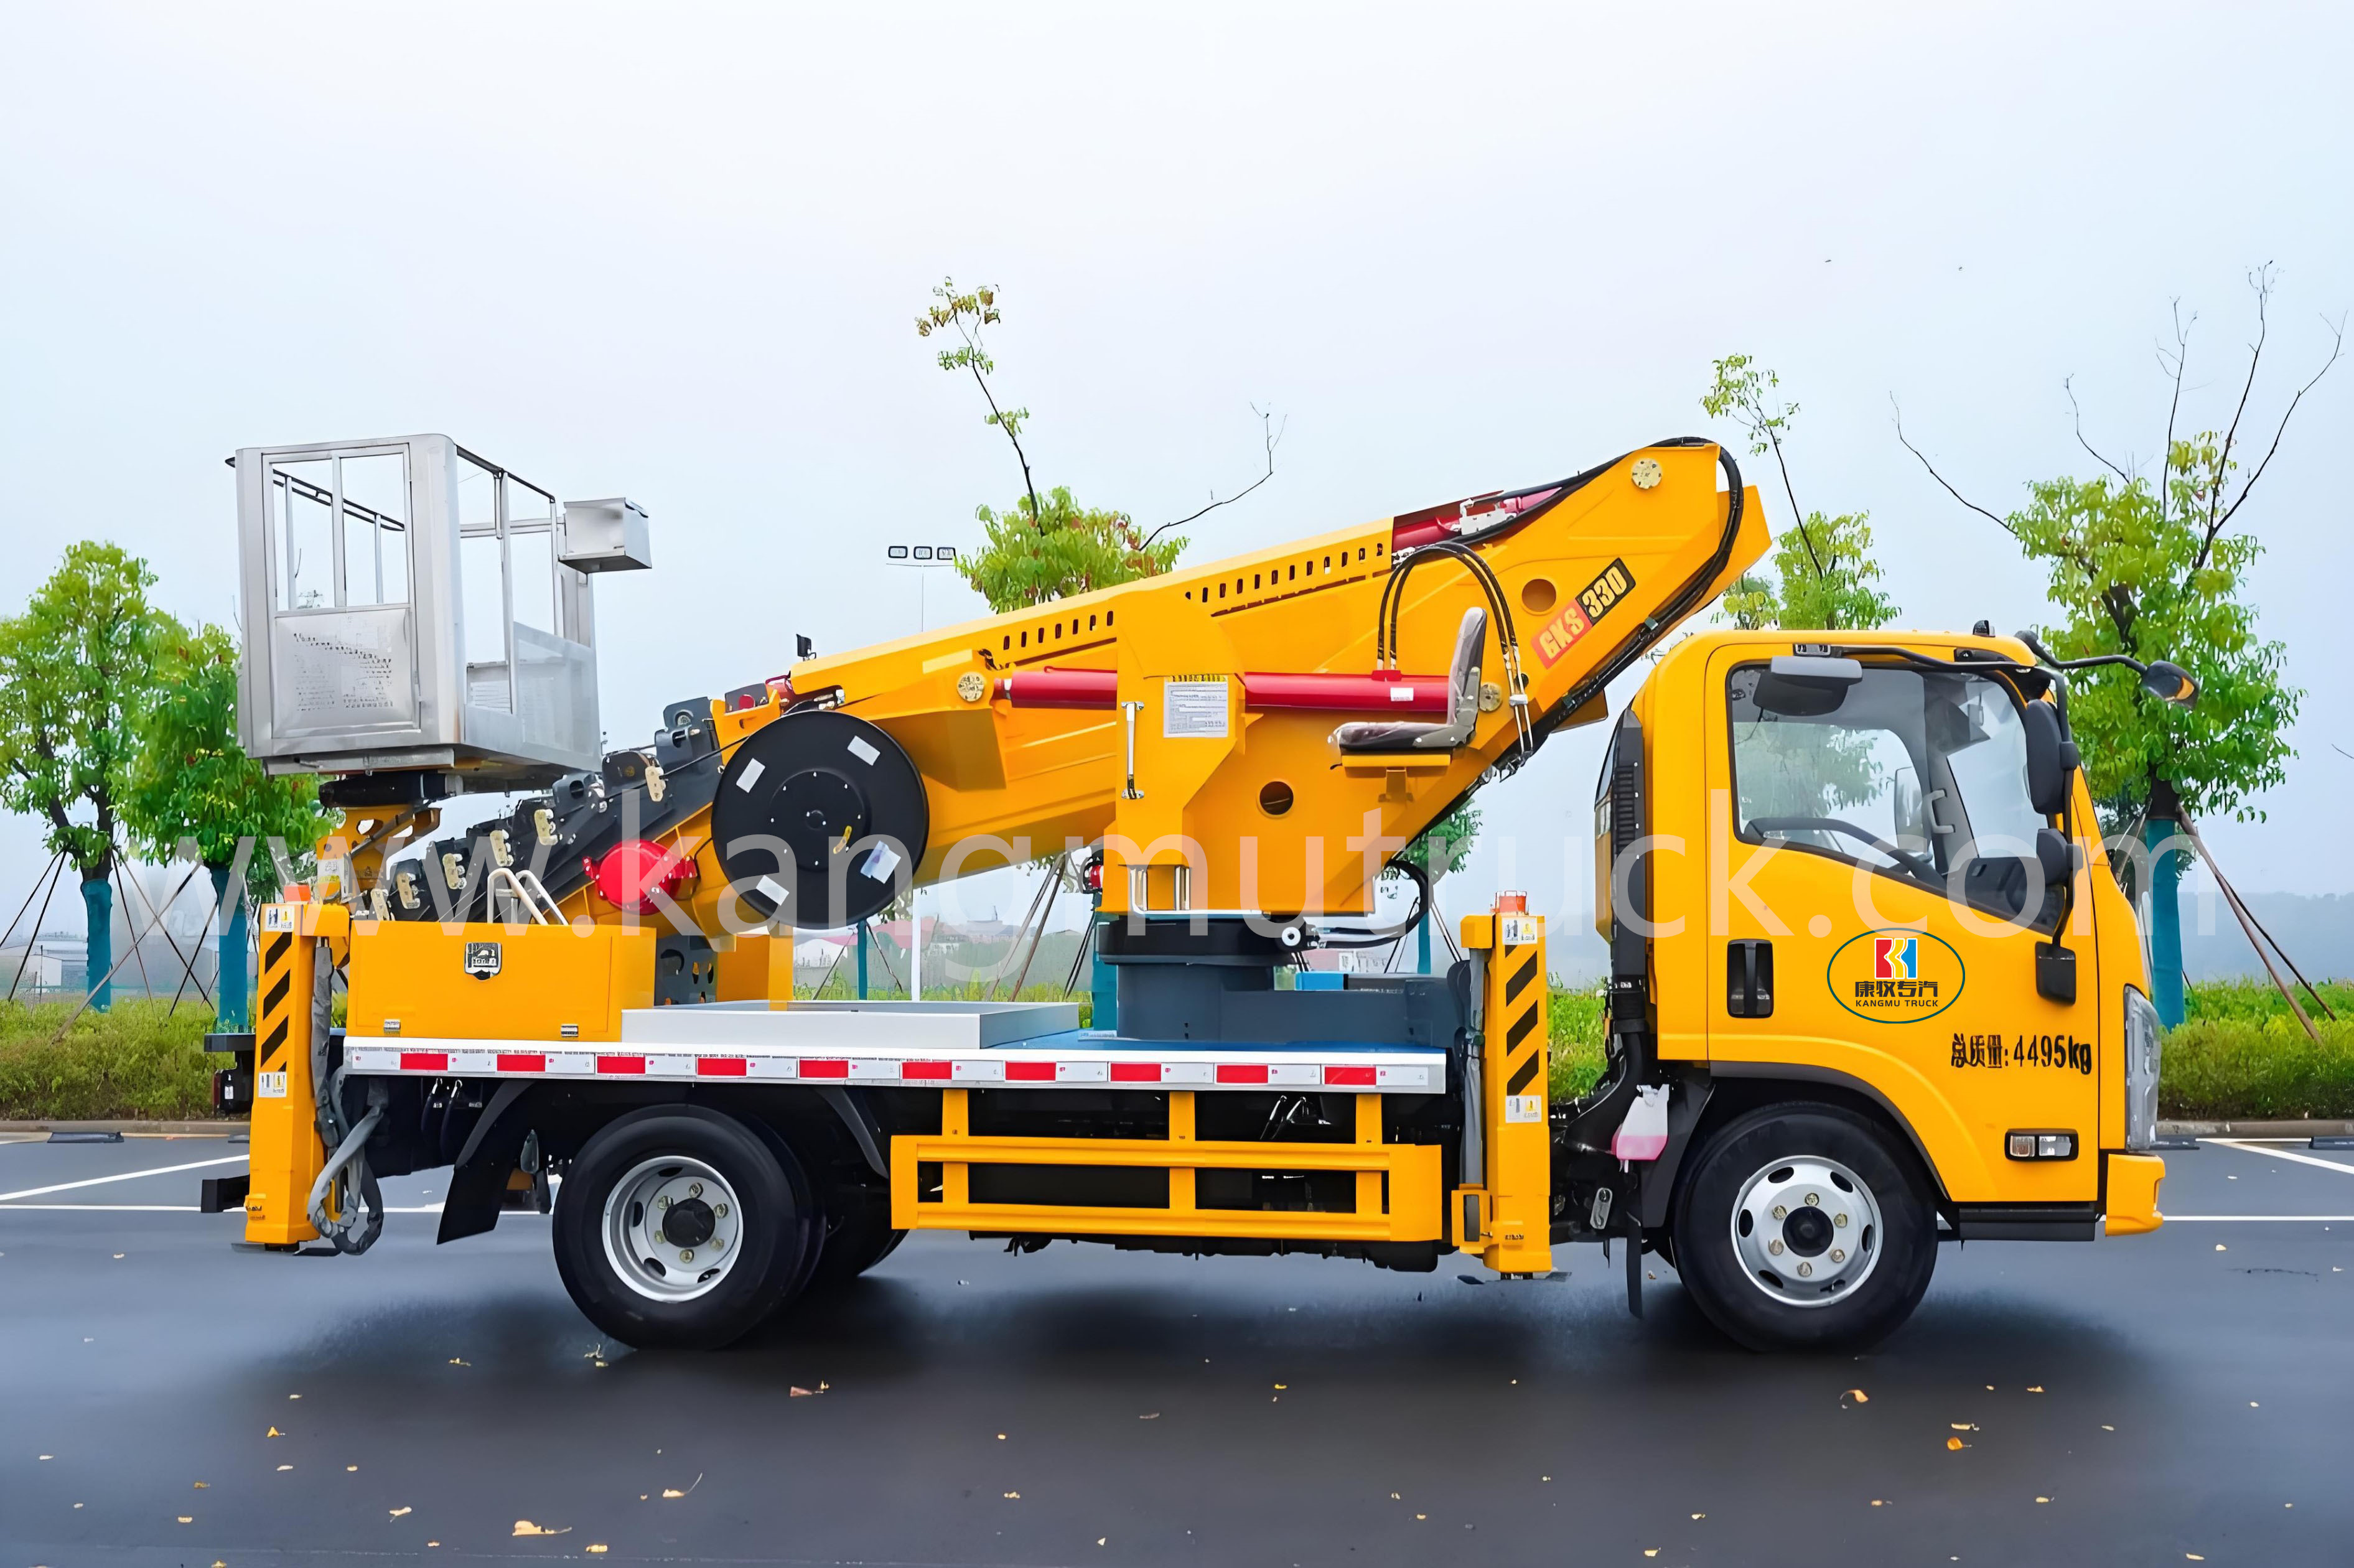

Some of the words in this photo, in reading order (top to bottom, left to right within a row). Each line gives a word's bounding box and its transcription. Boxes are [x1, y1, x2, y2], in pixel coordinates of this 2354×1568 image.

[1581, 566, 1627, 618] 330
[1855, 981, 1938, 997] 康牧专汽
